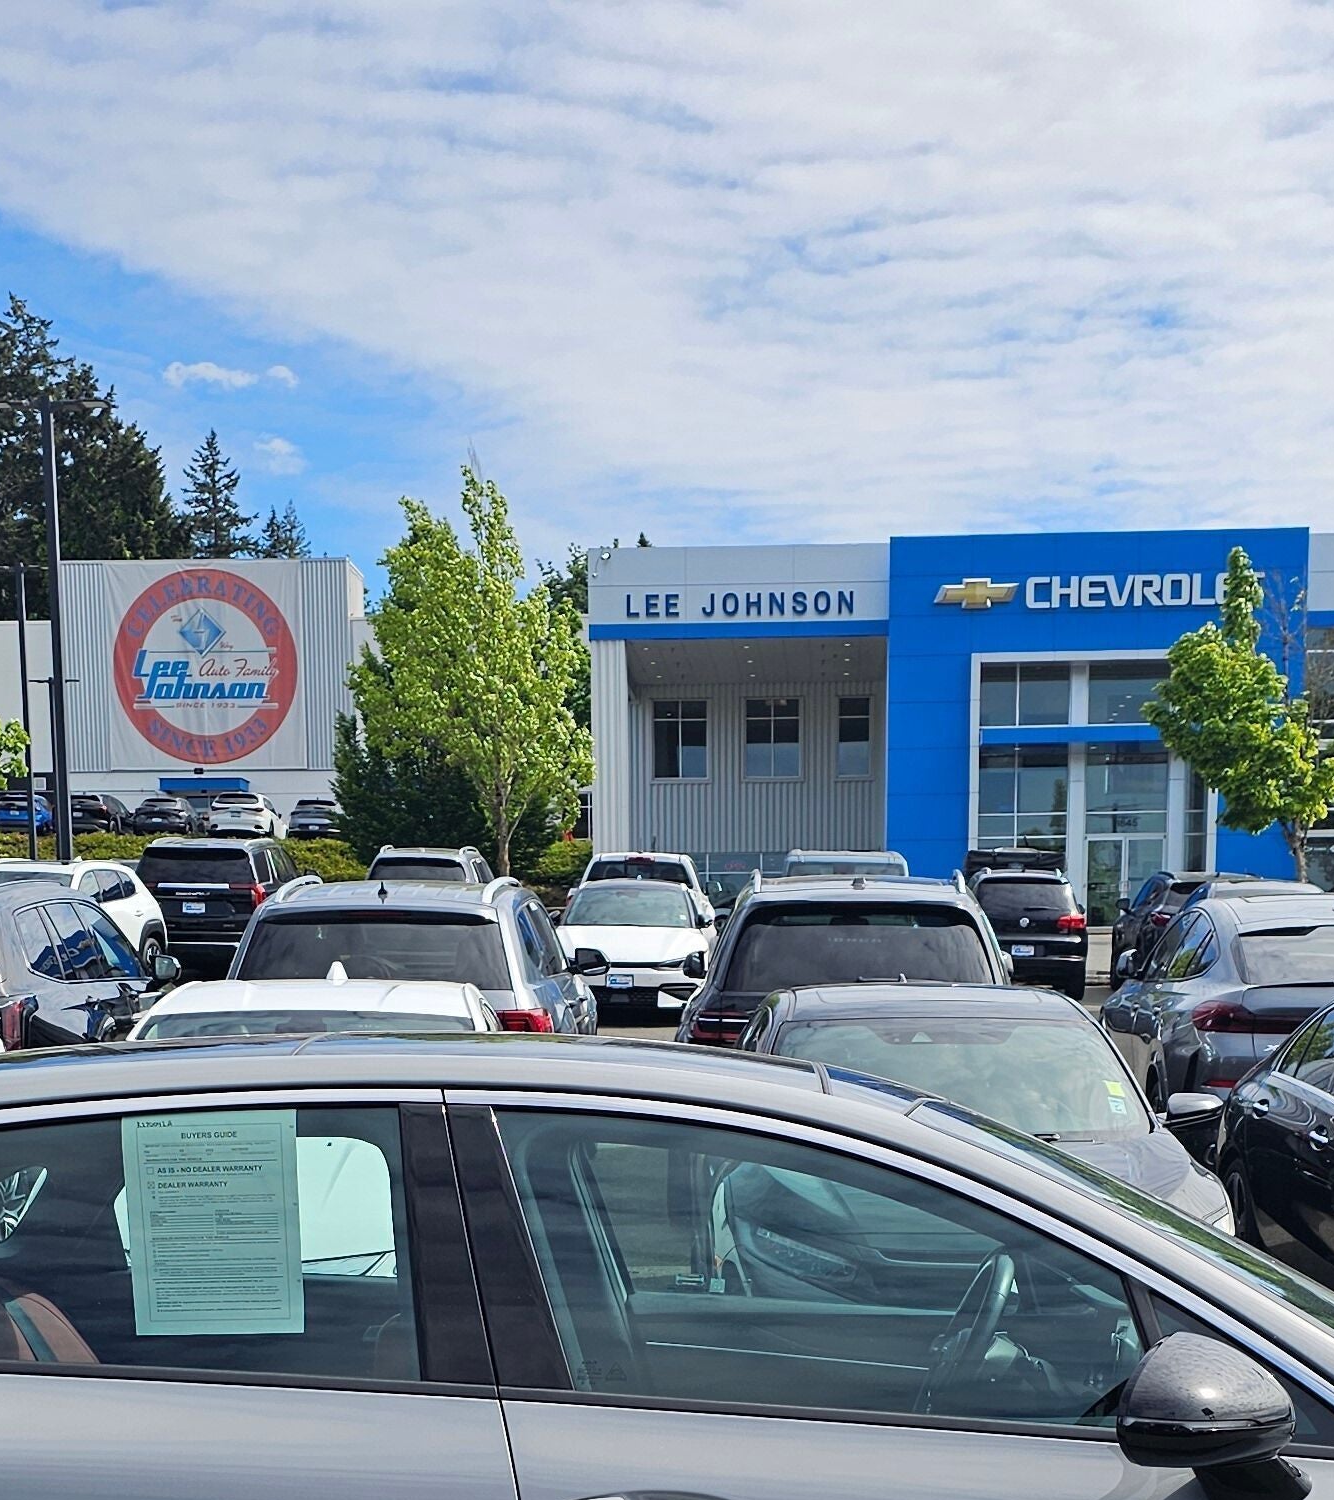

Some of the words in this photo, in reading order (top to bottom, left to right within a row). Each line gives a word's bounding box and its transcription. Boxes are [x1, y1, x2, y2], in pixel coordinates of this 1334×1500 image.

[1025, 571, 1265, 609] CHEVROLE
[127, 575, 281, 638] CELEBRATING
[626, 593, 680, 618] LEE
[701, 590, 855, 617] JOHNSON
[133, 649, 193, 677] Lee
[199, 657, 231, 677] Auto
[233, 657, 279, 684] Family
[136, 674, 269, 699] Johnson
[149, 718, 218, 758] SINCE
[224, 717, 268, 756] 1933
[180, 1131, 213, 1140] BUYERS
[213, 1131, 238, 1139] GUIDE
[192, 1165, 221, 1173] DEALER
[222, 1164, 263, 1172] WARRANTY
[157, 1181, 187, 1189] DEALER
[187, 1180, 228, 1188] WARRANTY
